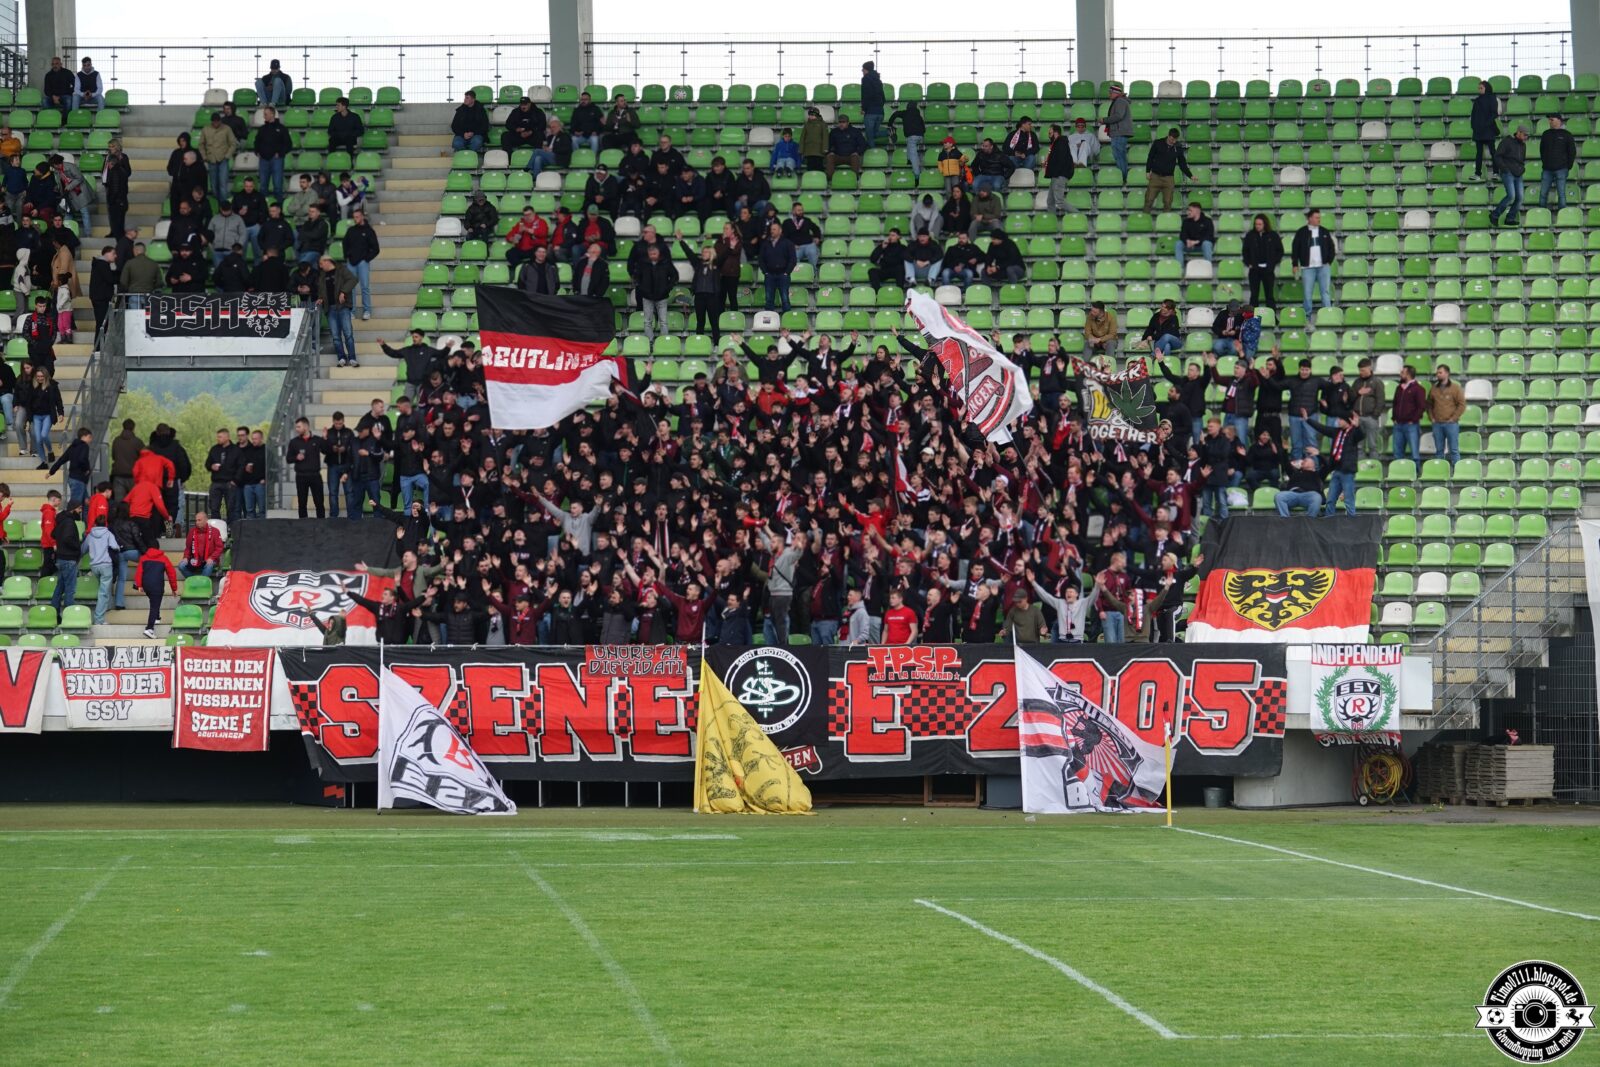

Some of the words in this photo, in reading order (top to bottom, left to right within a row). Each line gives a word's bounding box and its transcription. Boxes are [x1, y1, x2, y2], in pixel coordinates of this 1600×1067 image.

[148, 295, 240, 331] BS11
[59, 648, 108, 669] WIR
[111, 646, 173, 668] ALLE
[867, 646, 958, 674] TPSP
[1311, 644, 1402, 665] INDEPENDENT
[183, 658, 231, 673] GEGEN
[234, 660, 265, 673] DEN
[589, 660, 684, 675] DIFFIDATI
[66, 674, 116, 695] SIND
[120, 673, 165, 694] DER
[183, 676, 264, 691] MODERNEN
[1339, 682, 1378, 695] SSV
[86, 700, 133, 720] SSV
[184, 693, 262, 708] FUSSBALL!
[1351, 698, 1366, 714] R
[191, 711, 239, 732] SZENE
[242, 712, 253, 734] E
